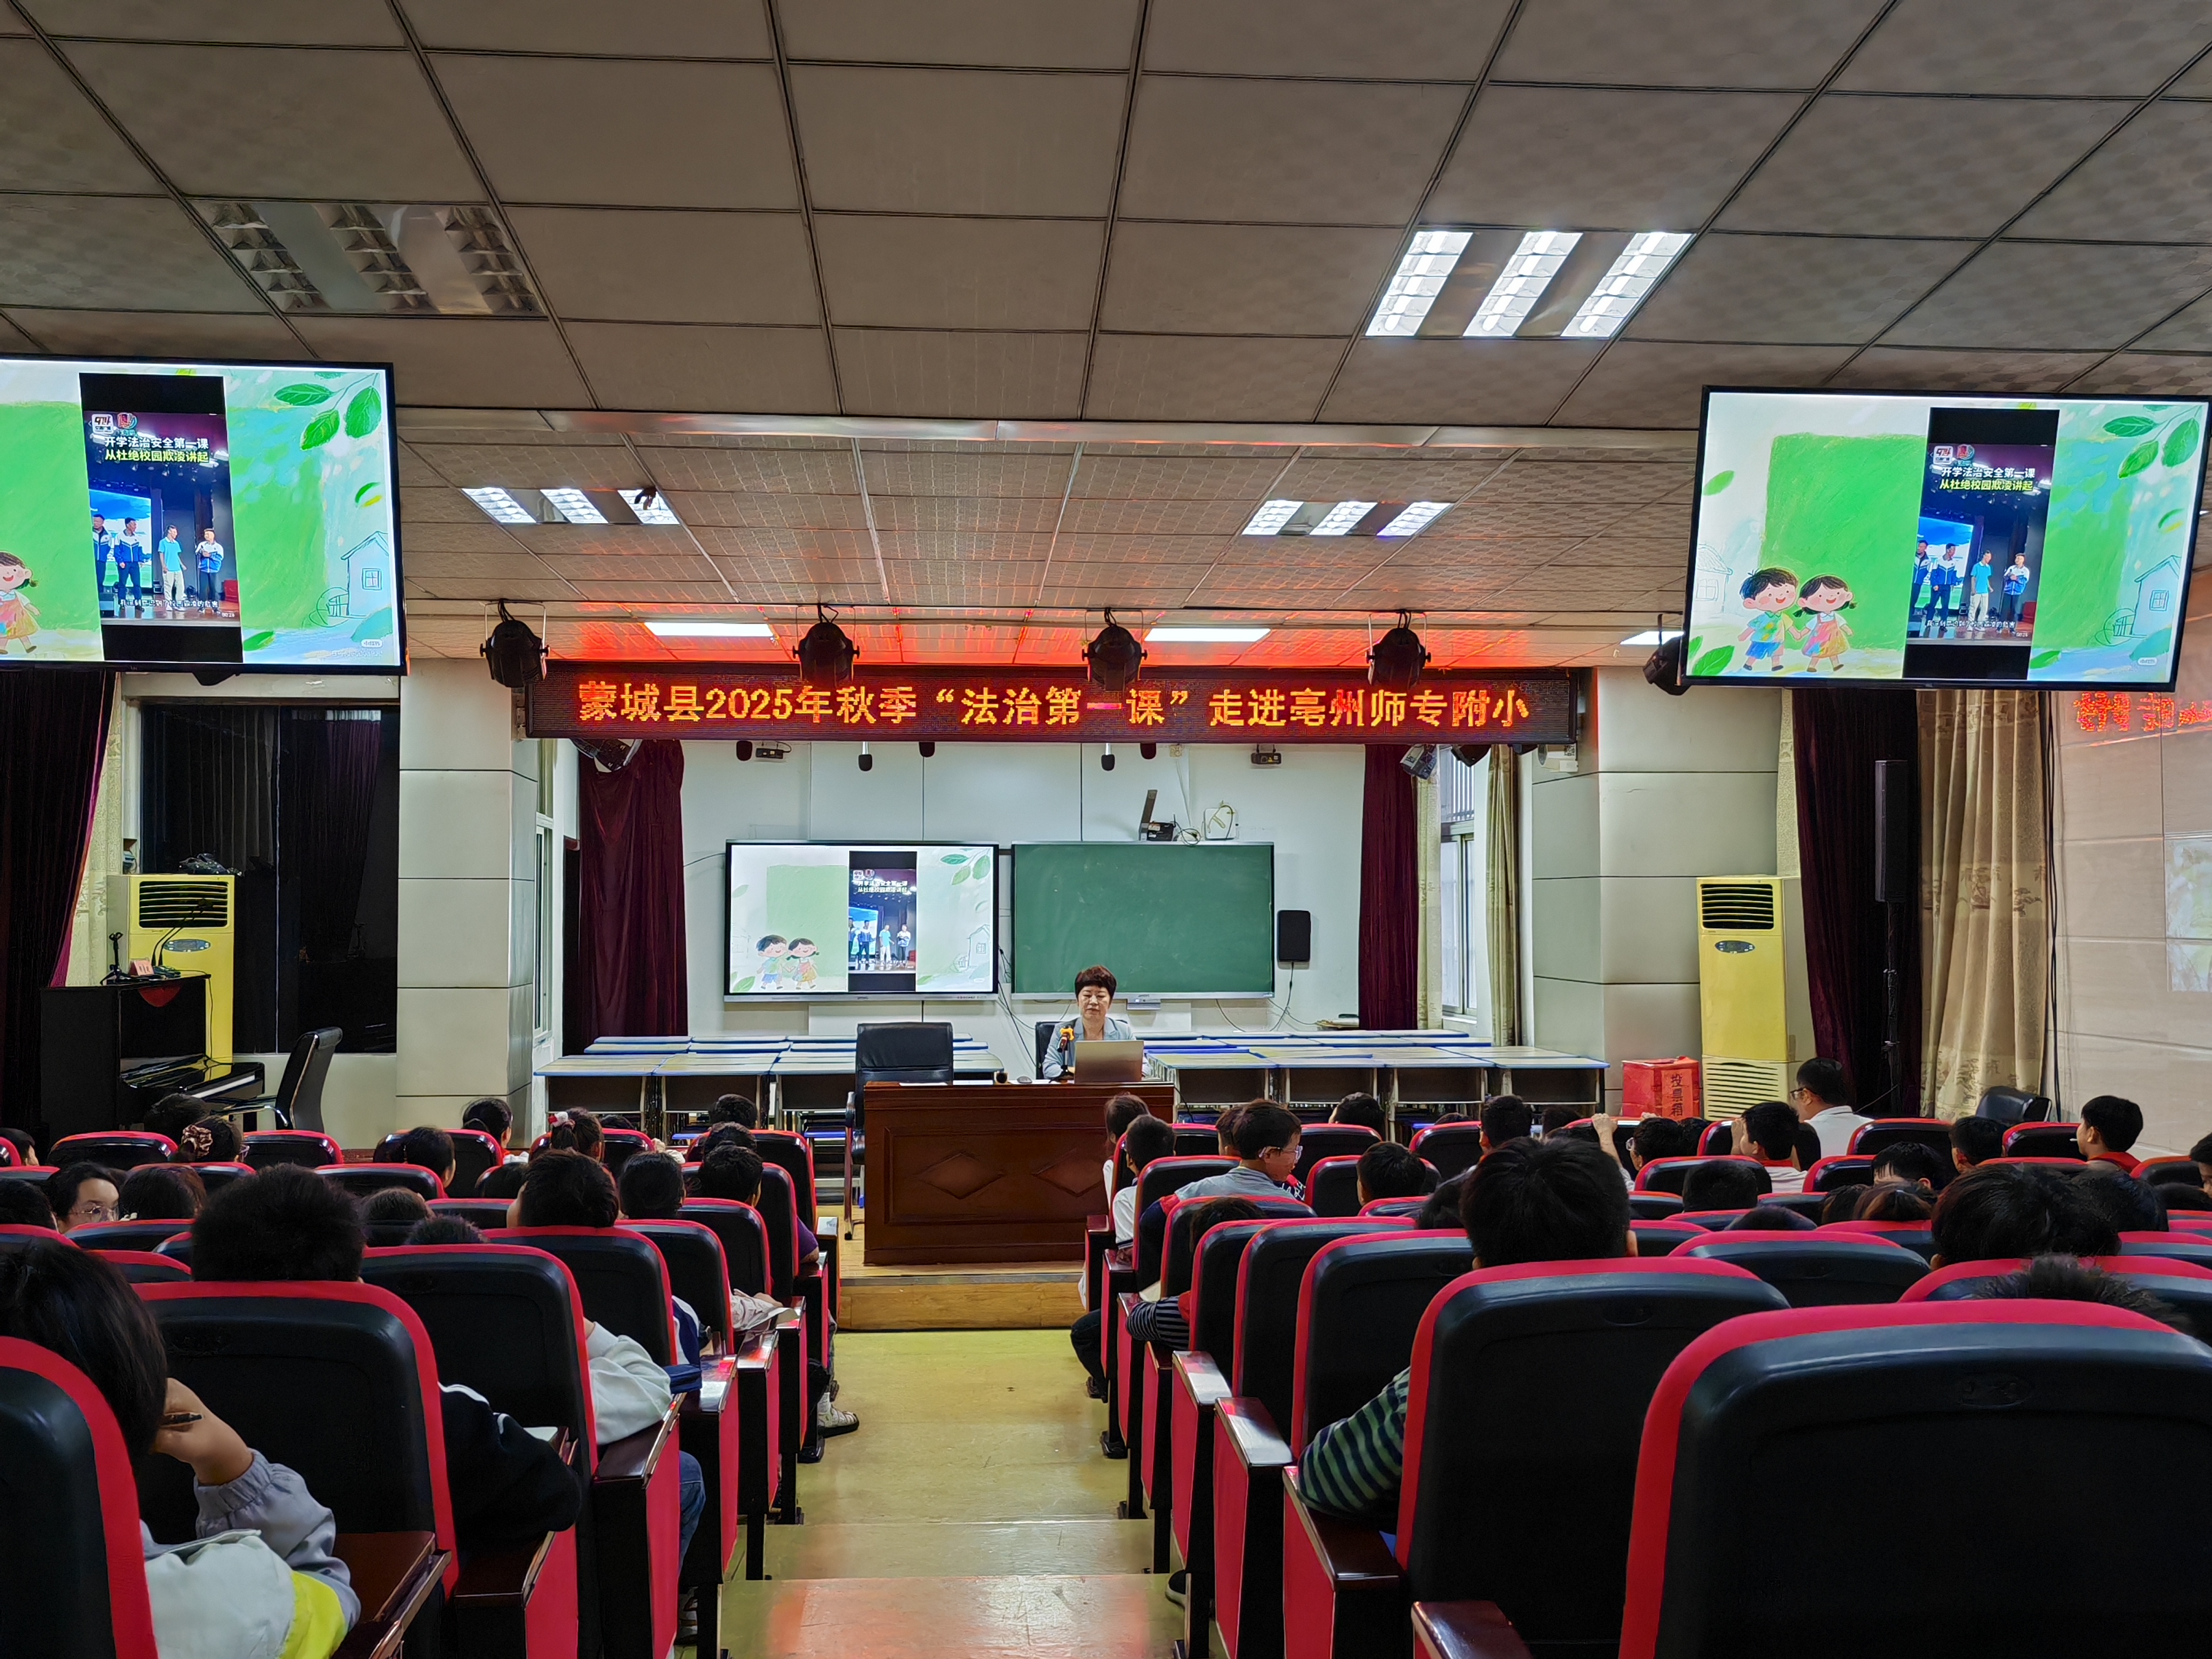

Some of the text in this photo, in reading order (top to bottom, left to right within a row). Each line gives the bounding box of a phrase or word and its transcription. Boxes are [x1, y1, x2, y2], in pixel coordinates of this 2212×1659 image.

[104, 436, 209, 449] 开学法治安全第一课
[105, 450, 209, 463] 从杜绝校园欺凌讲起
[1941, 467, 2035, 478] 开学法治安全第一课
[1939, 479, 2033, 491] 从杜绝校园欺凌讲起
